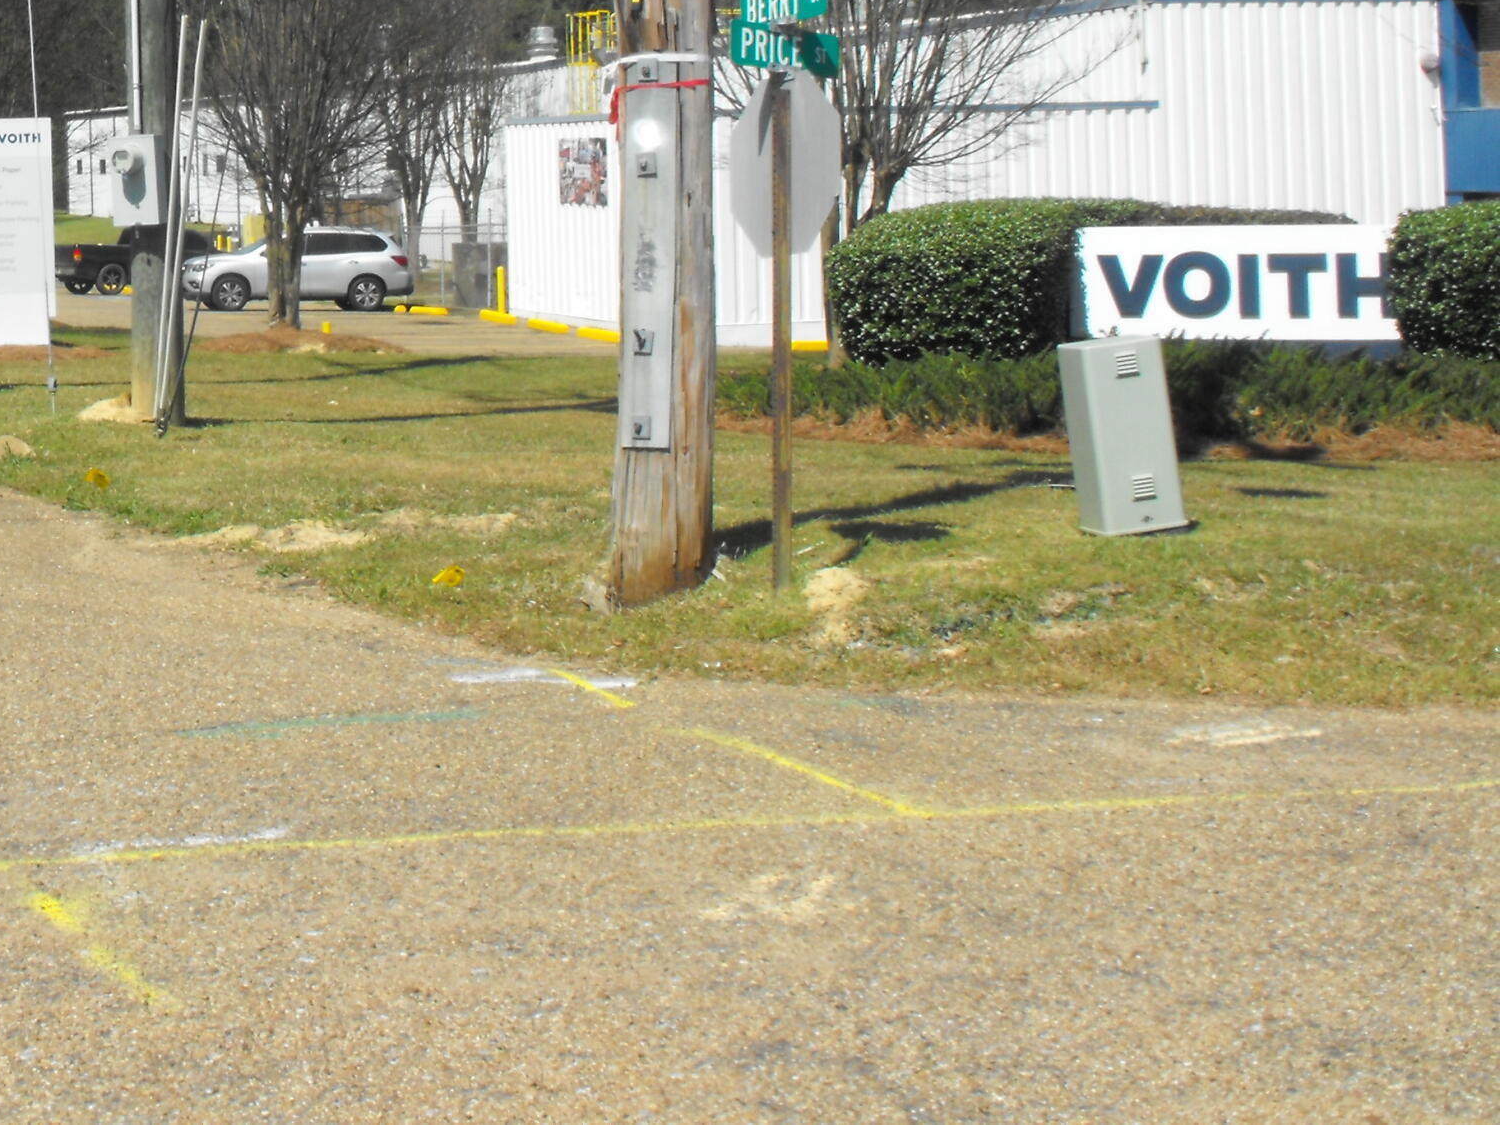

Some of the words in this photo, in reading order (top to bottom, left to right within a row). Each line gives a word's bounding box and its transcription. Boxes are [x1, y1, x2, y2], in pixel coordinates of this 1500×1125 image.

[741, 27, 803, 67] PRICE
[814, 46, 827, 64] ST
[1096, 250, 1395, 320] VOITH
